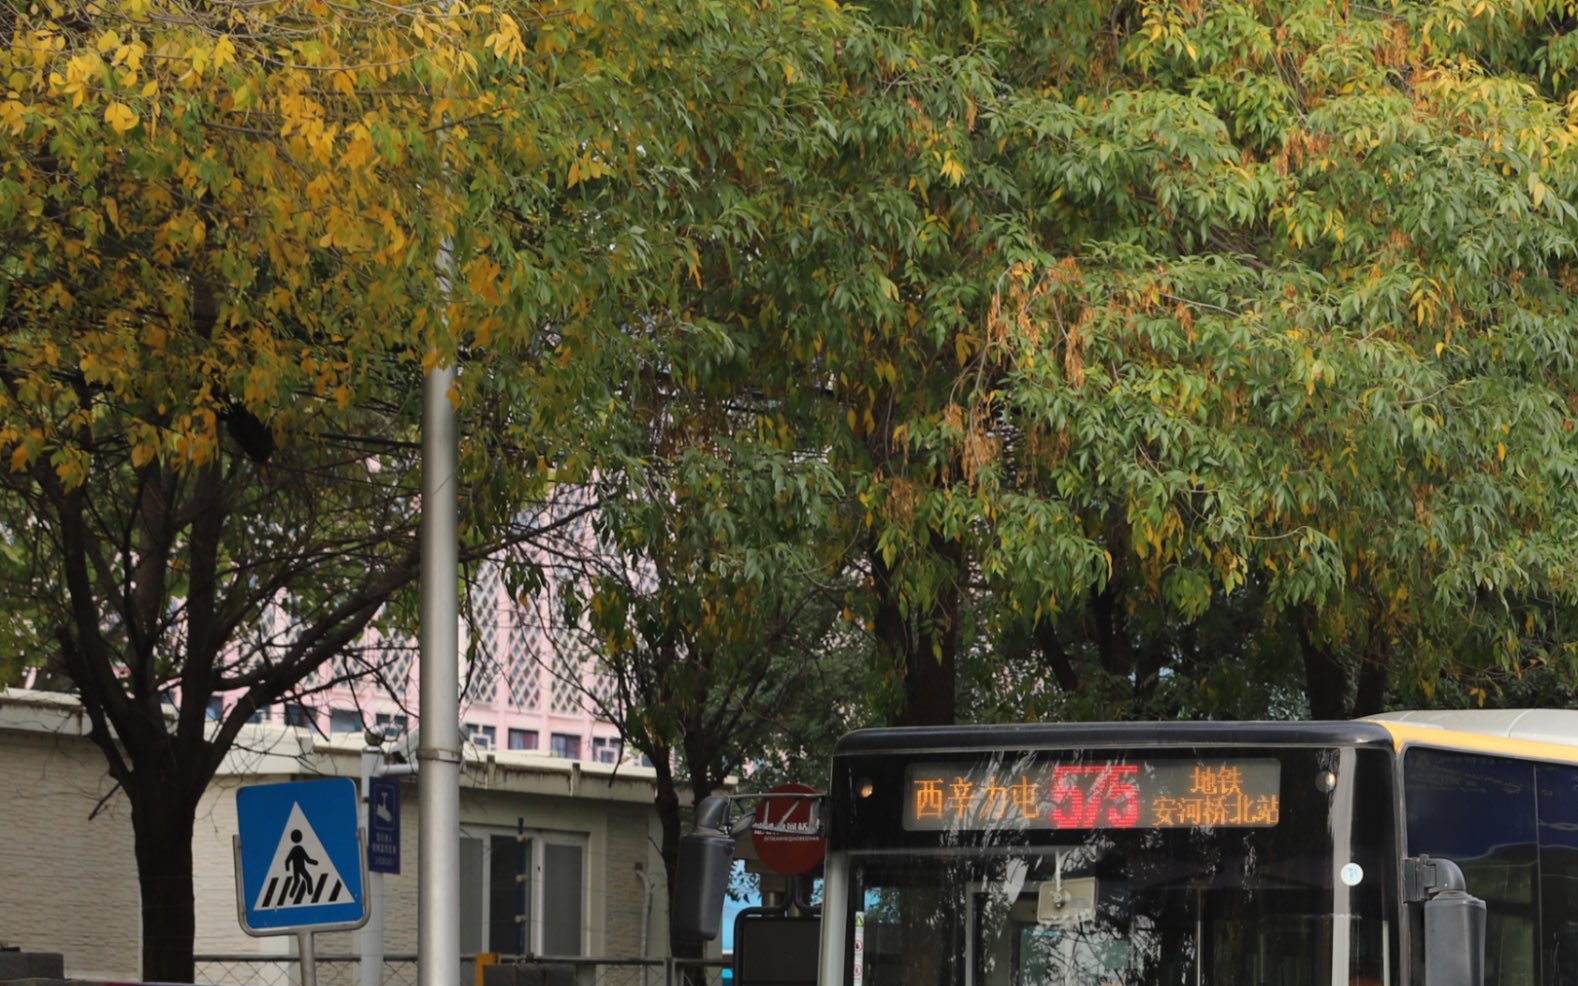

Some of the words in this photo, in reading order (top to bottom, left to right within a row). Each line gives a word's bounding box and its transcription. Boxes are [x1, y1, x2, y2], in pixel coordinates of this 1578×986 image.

[1190, 767, 1244, 794] 地铁
[1052, 765, 1139, 828] 575
[1151, 795, 1279, 826] 安河桥北站
